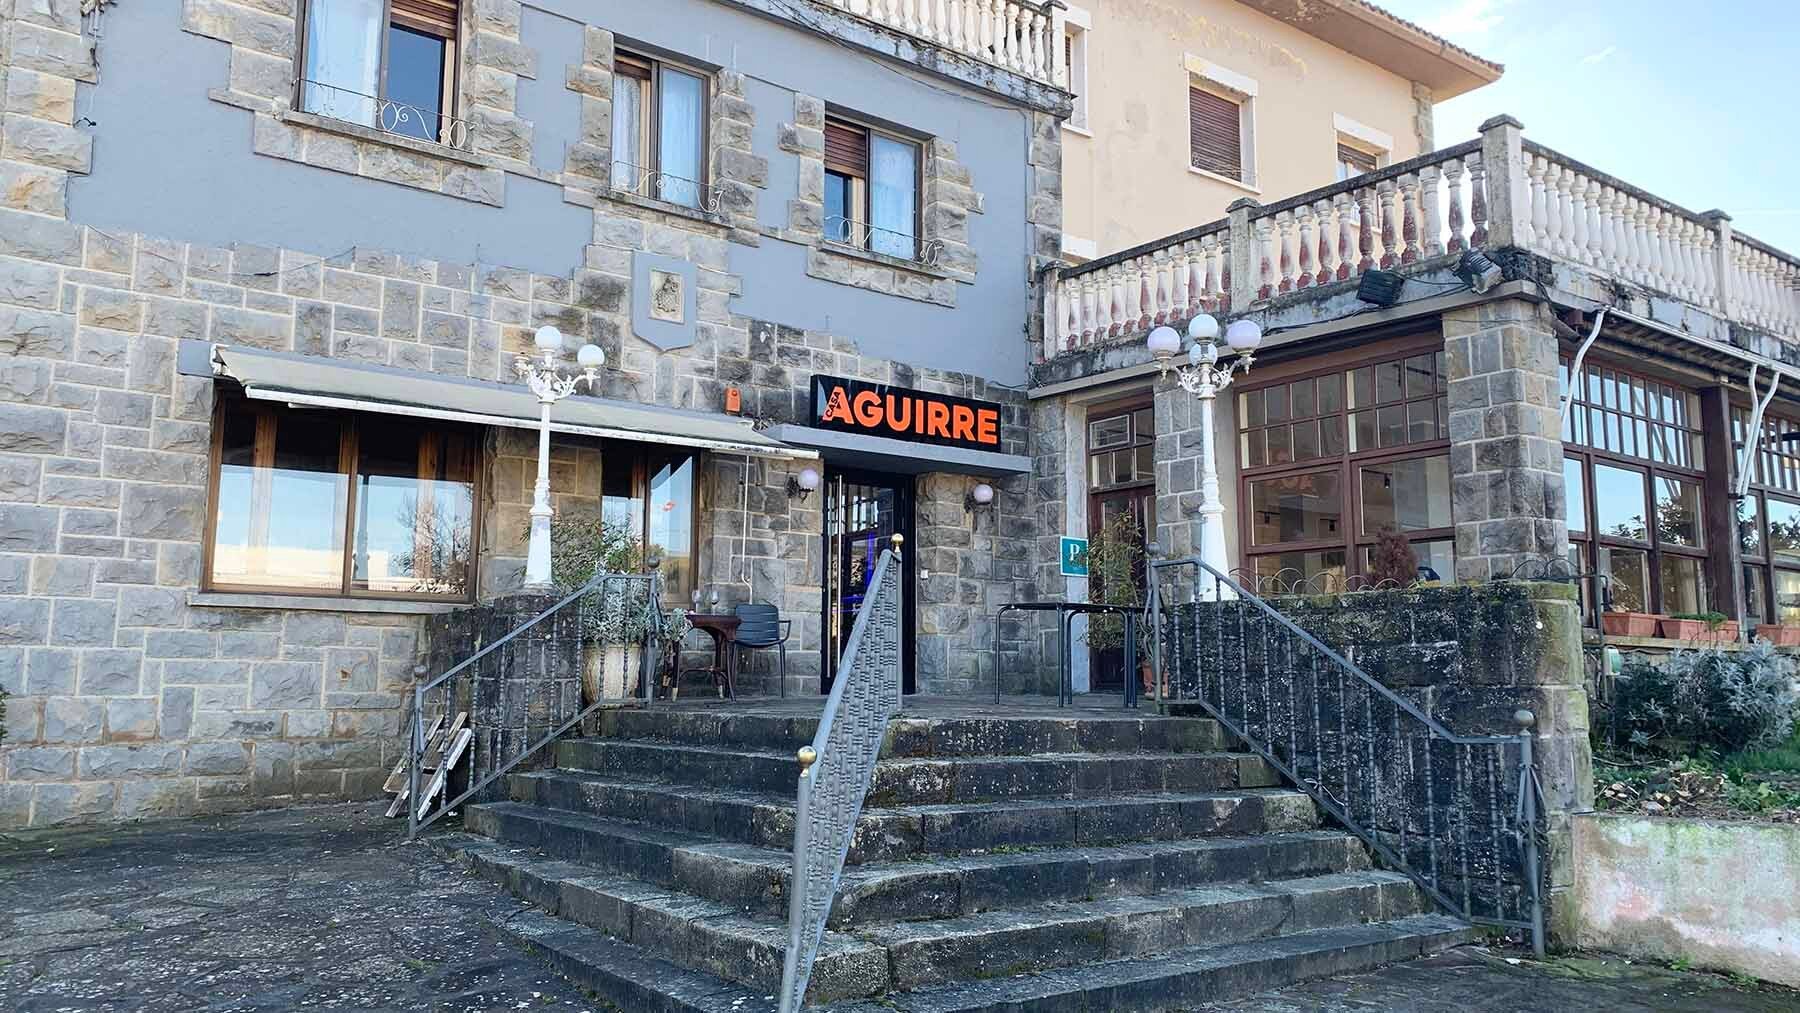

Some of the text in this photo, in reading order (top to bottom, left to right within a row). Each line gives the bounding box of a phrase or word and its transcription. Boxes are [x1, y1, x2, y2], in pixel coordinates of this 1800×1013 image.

[822, 385, 998, 444] AGUIRRE
[825, 391, 841, 417] CASA
[1069, 543, 1080, 561] P
